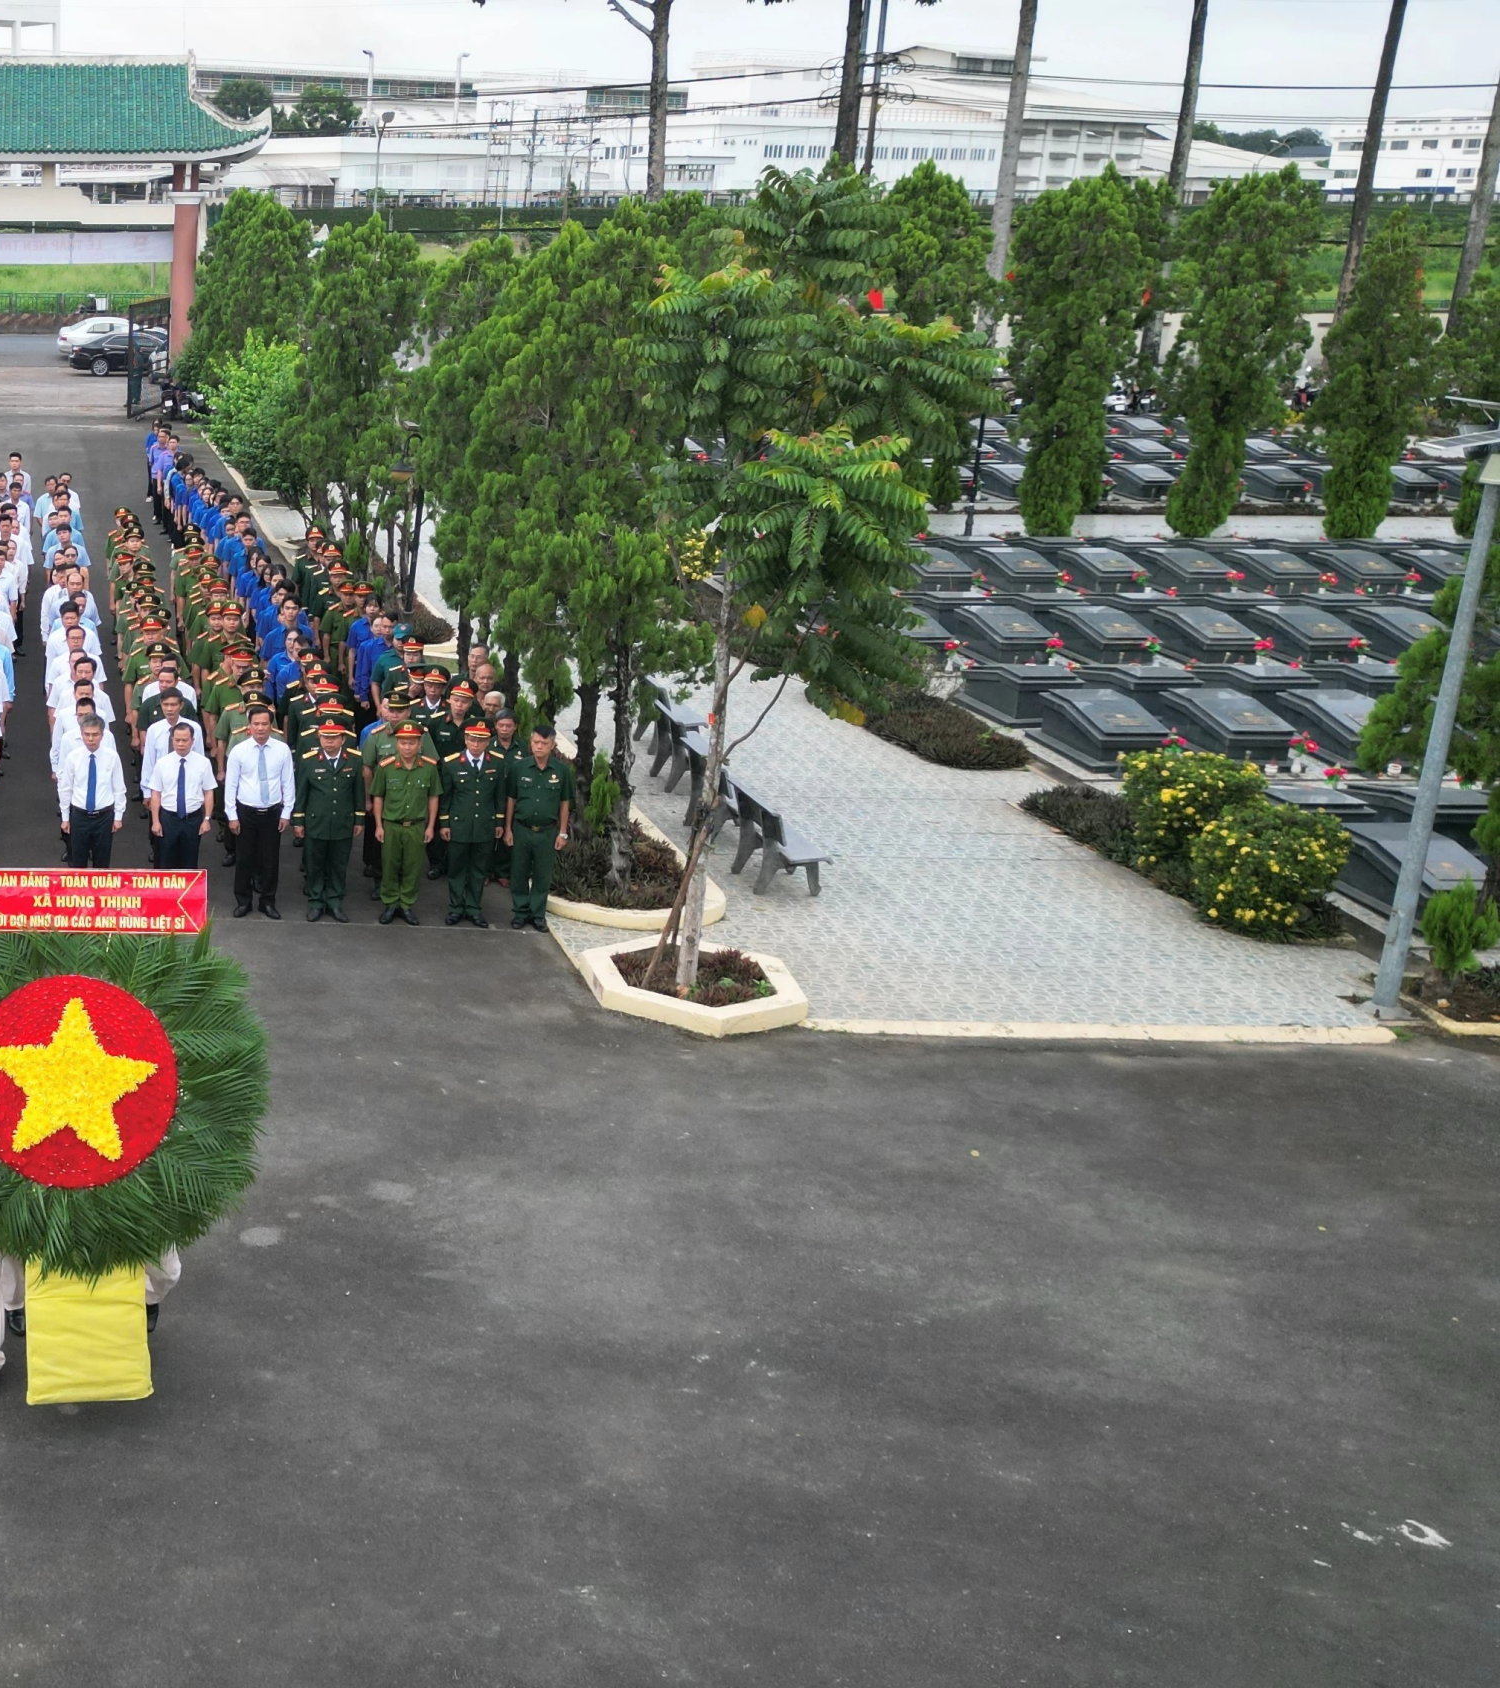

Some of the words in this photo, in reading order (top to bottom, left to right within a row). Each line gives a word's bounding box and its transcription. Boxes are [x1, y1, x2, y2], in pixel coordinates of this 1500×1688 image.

[20, 871, 50, 888] ĐẢNG
[60, 873, 89, 888] TOÀN
[91, 873, 122, 889] QUÂN
[131, 873, 160, 889] TOÀN
[162, 874, 186, 889] DÂN
[33, 893, 53, 907] XÃ
[56, 895, 96, 908] HƯNG
[99, 895, 142, 911] THỊNH
[29, 912, 52, 927] NHỚ
[53, 914, 69, 928] ƠN
[71, 913, 92, 928] CÁC
[94, 915, 117, 928] ANH
[119, 913, 148, 929] HÙNG
[150, 914, 172, 932] LIỆT
[174, 915, 186, 930] SĨ
